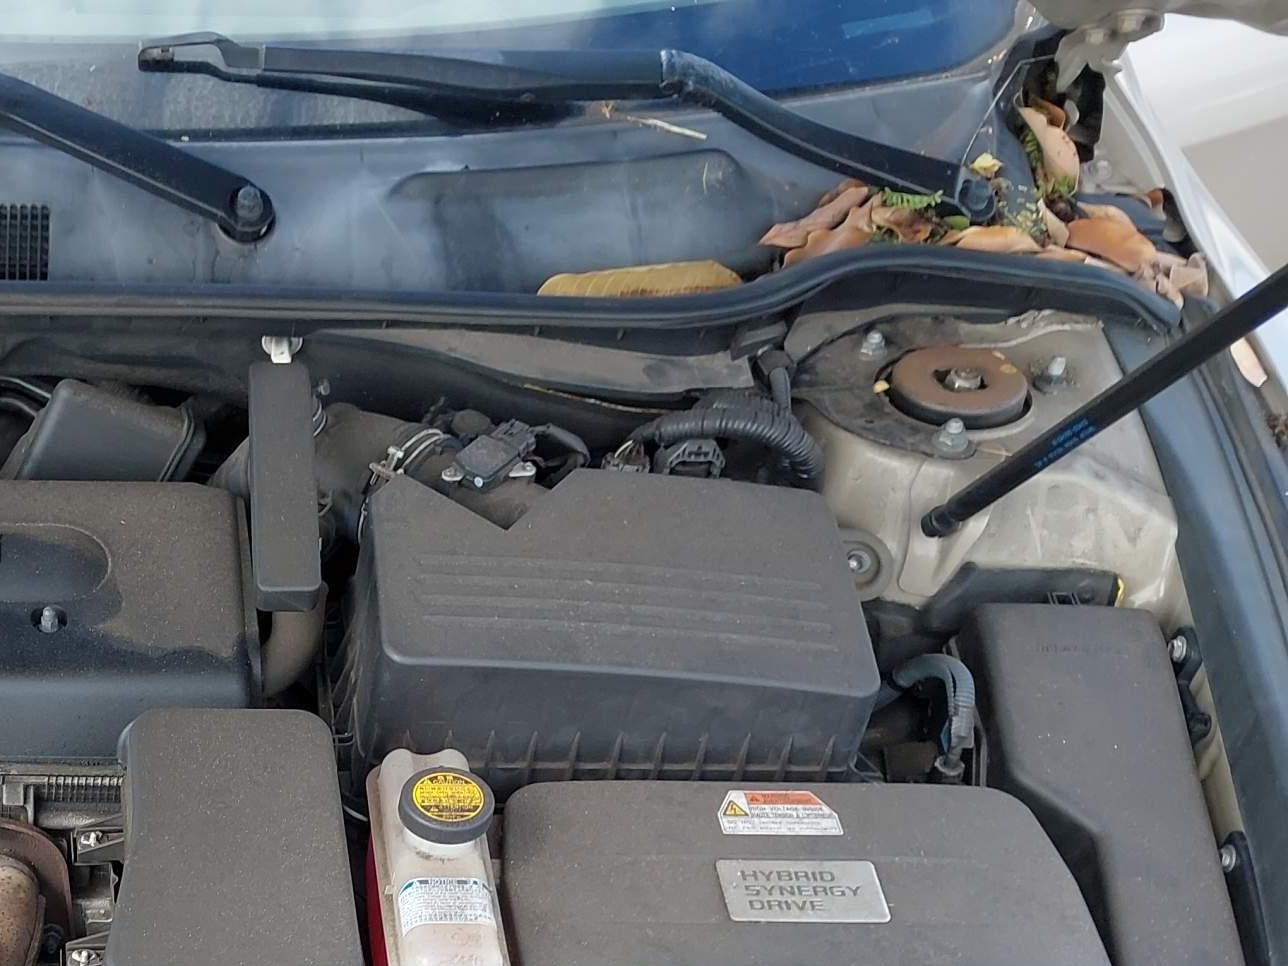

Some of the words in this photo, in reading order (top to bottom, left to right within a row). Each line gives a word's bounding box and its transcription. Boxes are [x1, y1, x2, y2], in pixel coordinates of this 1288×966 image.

[741, 870, 836, 882] HYBRID
[745, 884, 862, 897] SYNERGY
[748, 900, 825, 911] DRIVE
